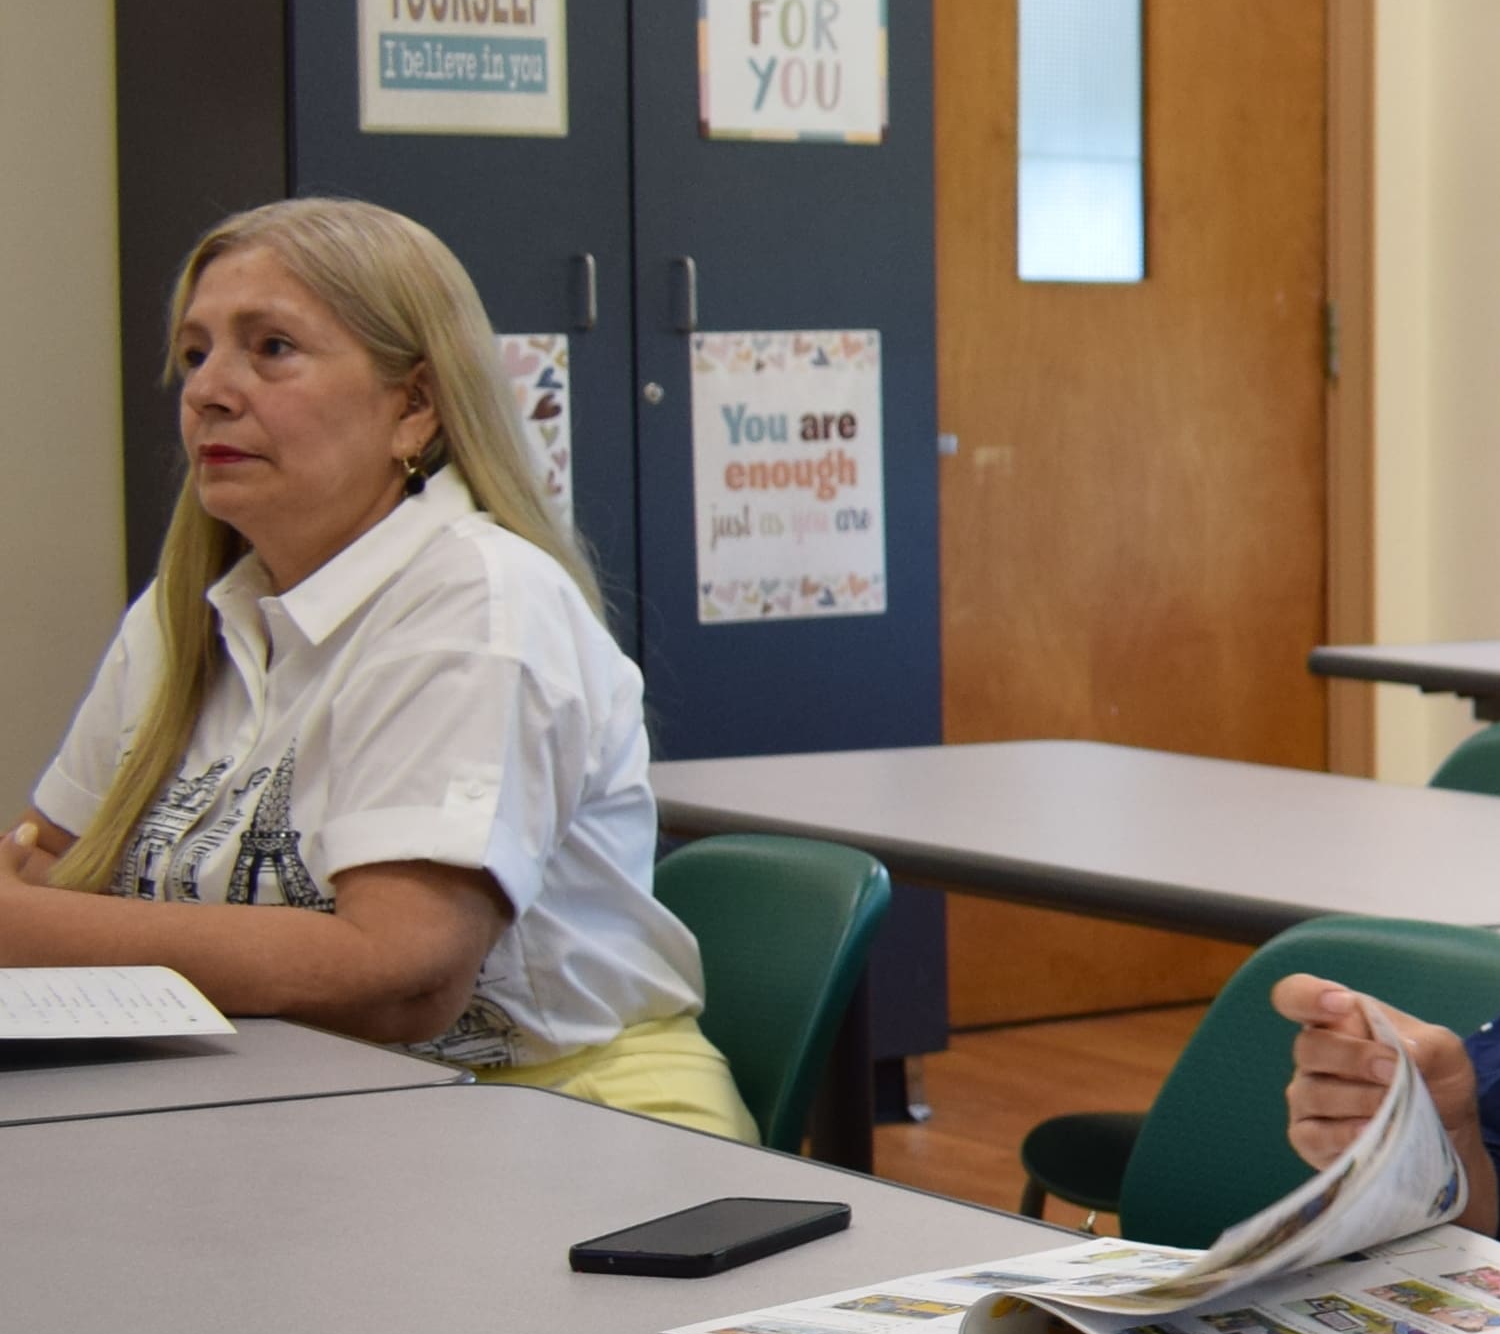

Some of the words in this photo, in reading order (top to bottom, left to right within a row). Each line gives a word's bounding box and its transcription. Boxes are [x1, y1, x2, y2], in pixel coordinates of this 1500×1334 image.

[384, 40, 396, 78] I
[401, 41, 477, 81] believe
[482, 43, 504, 80] in
[509, 53, 544, 89] you
[747, 55, 842, 111] YOU
[721, 403, 788, 445] You
[799, 409, 857, 442] are
[724, 448, 857, 502] enough
[710, 502, 752, 551] just
[834, 506, 871, 532] are
